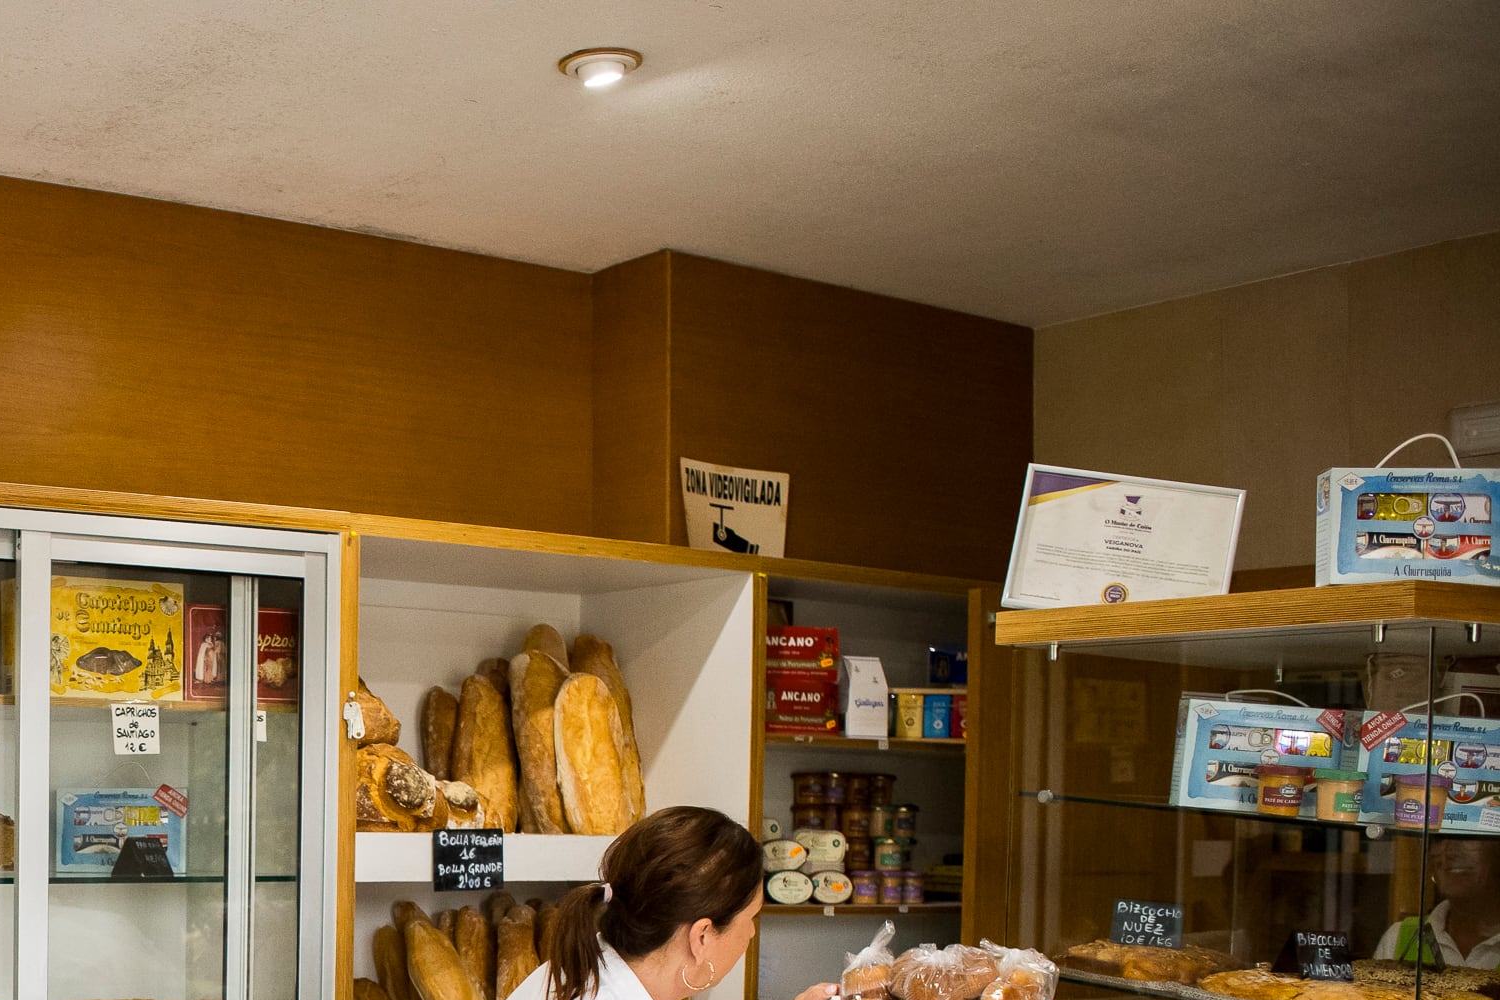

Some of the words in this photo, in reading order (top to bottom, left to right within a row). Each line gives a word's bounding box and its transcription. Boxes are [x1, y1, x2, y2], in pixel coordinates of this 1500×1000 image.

[1386, 472, 1424, 484] Conservas
[1426, 472, 1450, 483] Roma
[685, 467, 707, 496] ZONA
[709, 472, 781, 506] VIDEOVIGILADA
[1104, 539, 1143, 549] VEIGANOVA
[1372, 535, 1377, 543] A
[1394, 567, 1400, 576] A
[1404, 564, 1452, 580] Churrusquiña
[76, 592, 156, 617] Caprichos
[75, 609, 152, 640] Santiago
[766, 636, 814, 647] ANCANO
[781, 690, 821, 702] ANCANO
[115, 707, 157, 718] CAPRICHOS
[129, 720, 139, 729] de
[1325, 712, 1342, 729] TIENDA
[1367, 713, 1388, 730] AHORA
[1362, 729, 1382, 744] TIENDA
[1381, 713, 1402, 730] ONLINE
[1452, 722, 1473, 733] Roma
[116, 729, 155, 739] SANTIAGO
[125, 743, 136, 752] 12
[139, 742, 147, 752] €
[438, 864, 465, 876] BOLLA
[468, 862, 503, 876] GRANDE
[484, 876, 491, 888] €
[1140, 915, 1156, 923] DE
[1122, 921, 1165, 936] NUEZ
[1318, 948, 1331, 959] DE
